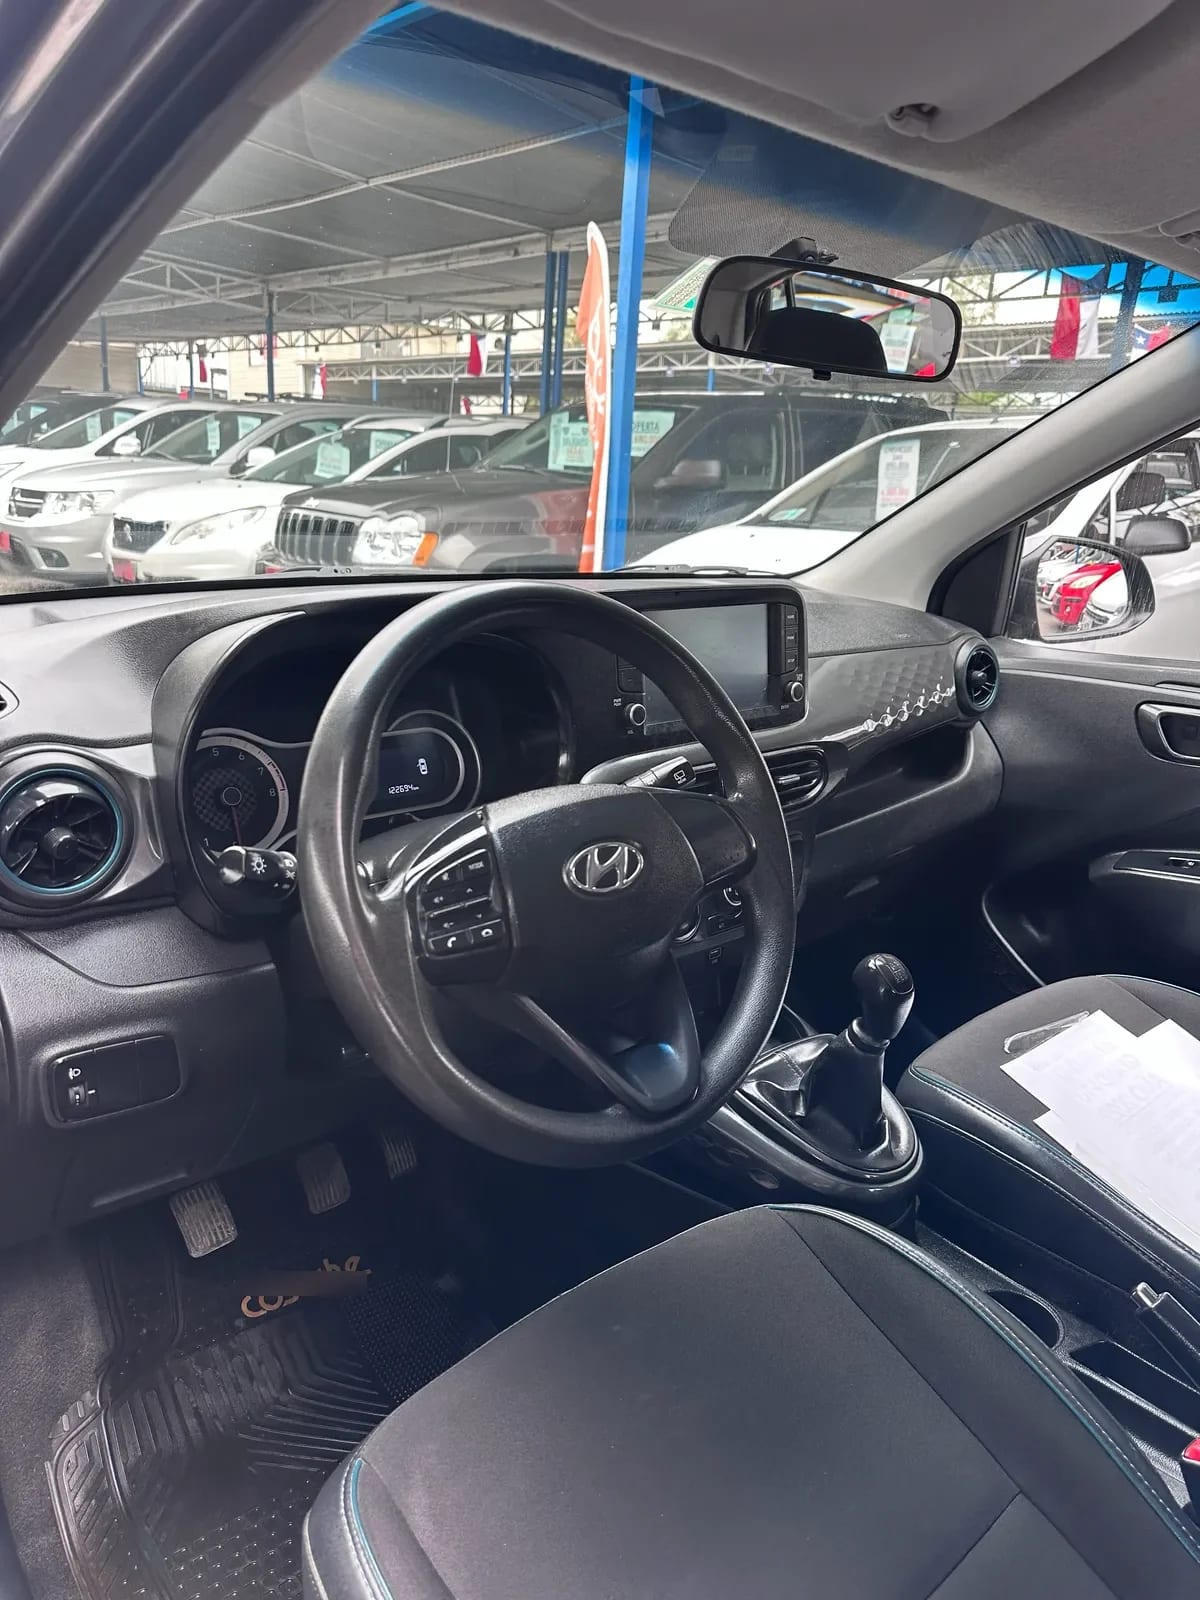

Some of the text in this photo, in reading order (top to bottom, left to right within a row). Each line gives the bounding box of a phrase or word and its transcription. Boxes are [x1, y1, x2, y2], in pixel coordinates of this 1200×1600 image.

[212, 747, 219, 757] 5
[238, 752, 246, 761] 6
[257, 766, 264, 776] 7
[269, 787, 276, 797] 8
[388, 783, 413, 794] 122694
